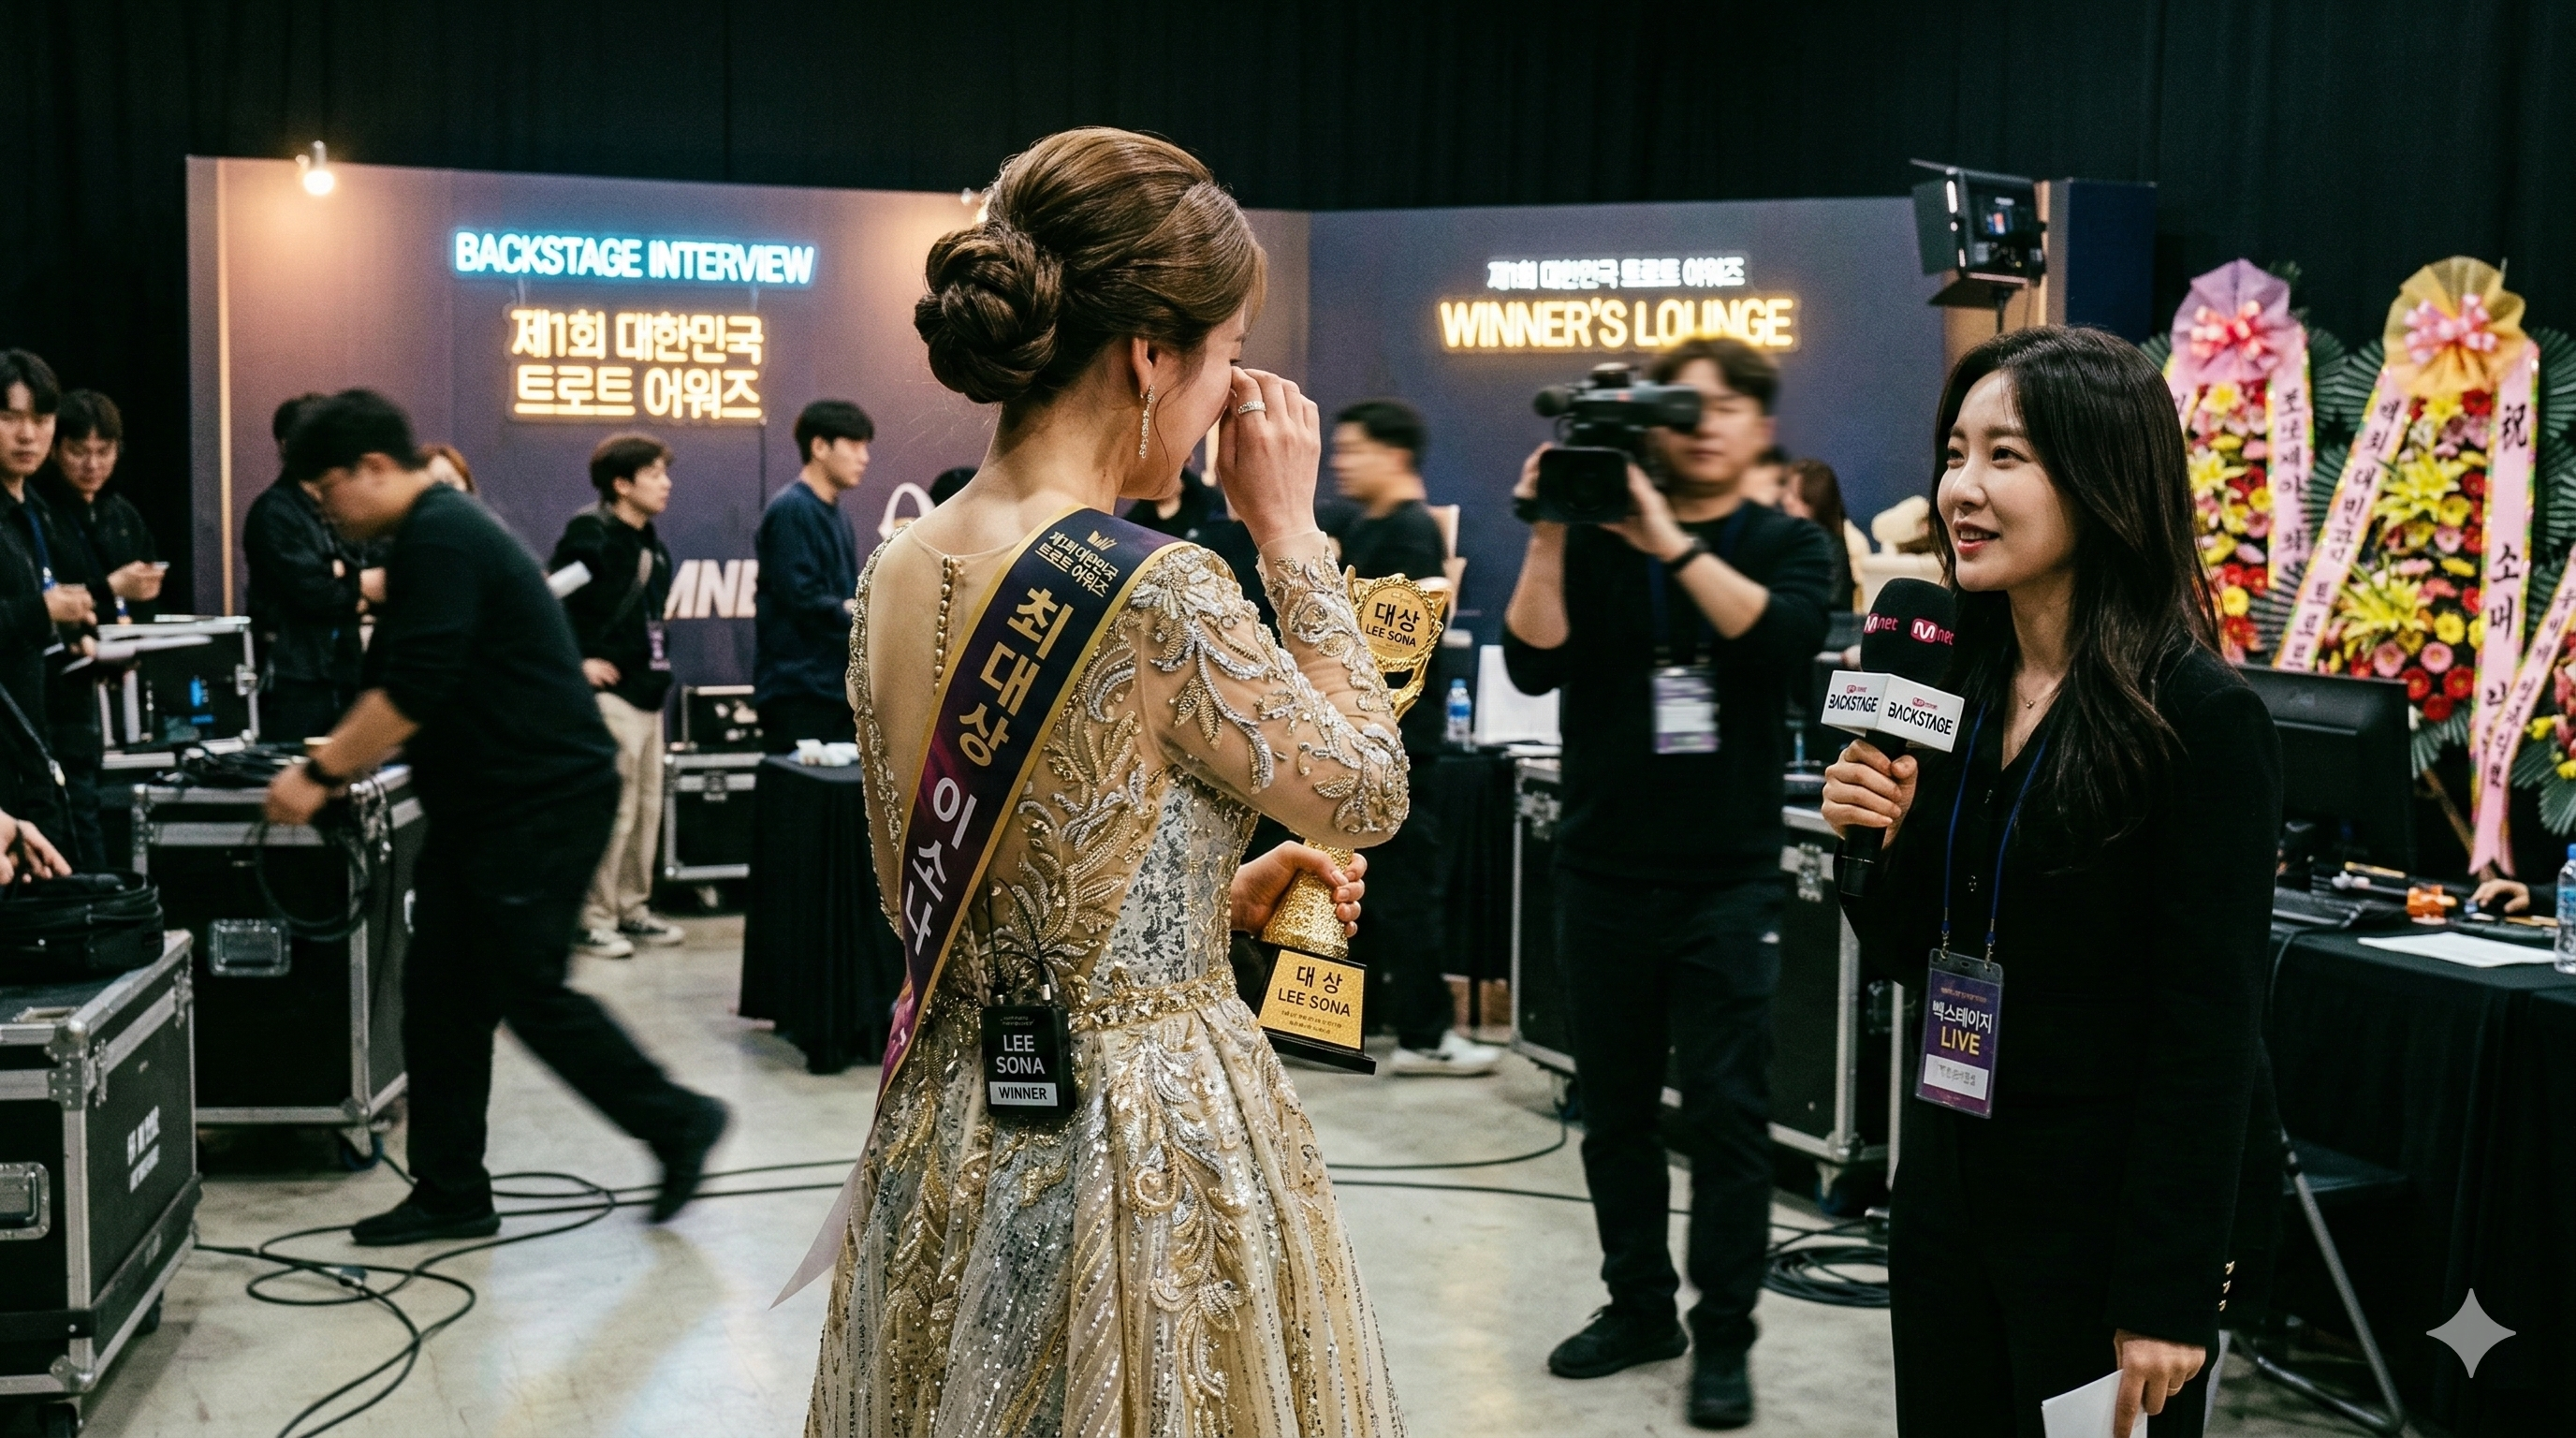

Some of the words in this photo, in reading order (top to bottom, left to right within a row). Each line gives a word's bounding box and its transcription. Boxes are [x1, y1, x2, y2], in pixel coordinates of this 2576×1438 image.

[456, 232, 643, 278] BACKSTAGE
[649, 240, 814, 283] INTERVIEW
[1620, 258, 1681, 287] 트로트
[511, 308, 606, 360] 제1회
[615, 311, 764, 365] 대한민국
[1440, 297, 1628, 347] WINNER'S
[1634, 299, 1793, 347] LOUNGE
[514, 364, 636, 416] 트로트
[643, 367, 762, 419] 어워즈
[1034, 542, 1074, 573] 트로트
[1071, 565, 1109, 597] 어워즈
[1375, 603, 1420, 632] 대상
[1864, 613, 1898, 633] Mnet
[1366, 624, 1385, 638] LEE
[1387, 630, 1416, 647] SONA
[959, 587, 1075, 767] 최대상
[1828, 694, 1879, 712] BACKSTAGE
[1888, 702, 1954, 735] BACKSTAGE
[1278, 988, 1306, 1005] LEE
[1310, 995, 1350, 1017] SONA
[1003, 1034, 1035, 1052] LEE
[1940, 1026, 1981, 1056] LIVE
[996, 1056, 1046, 1075] SONA
[999, 1087, 1047, 1100] WINNER
